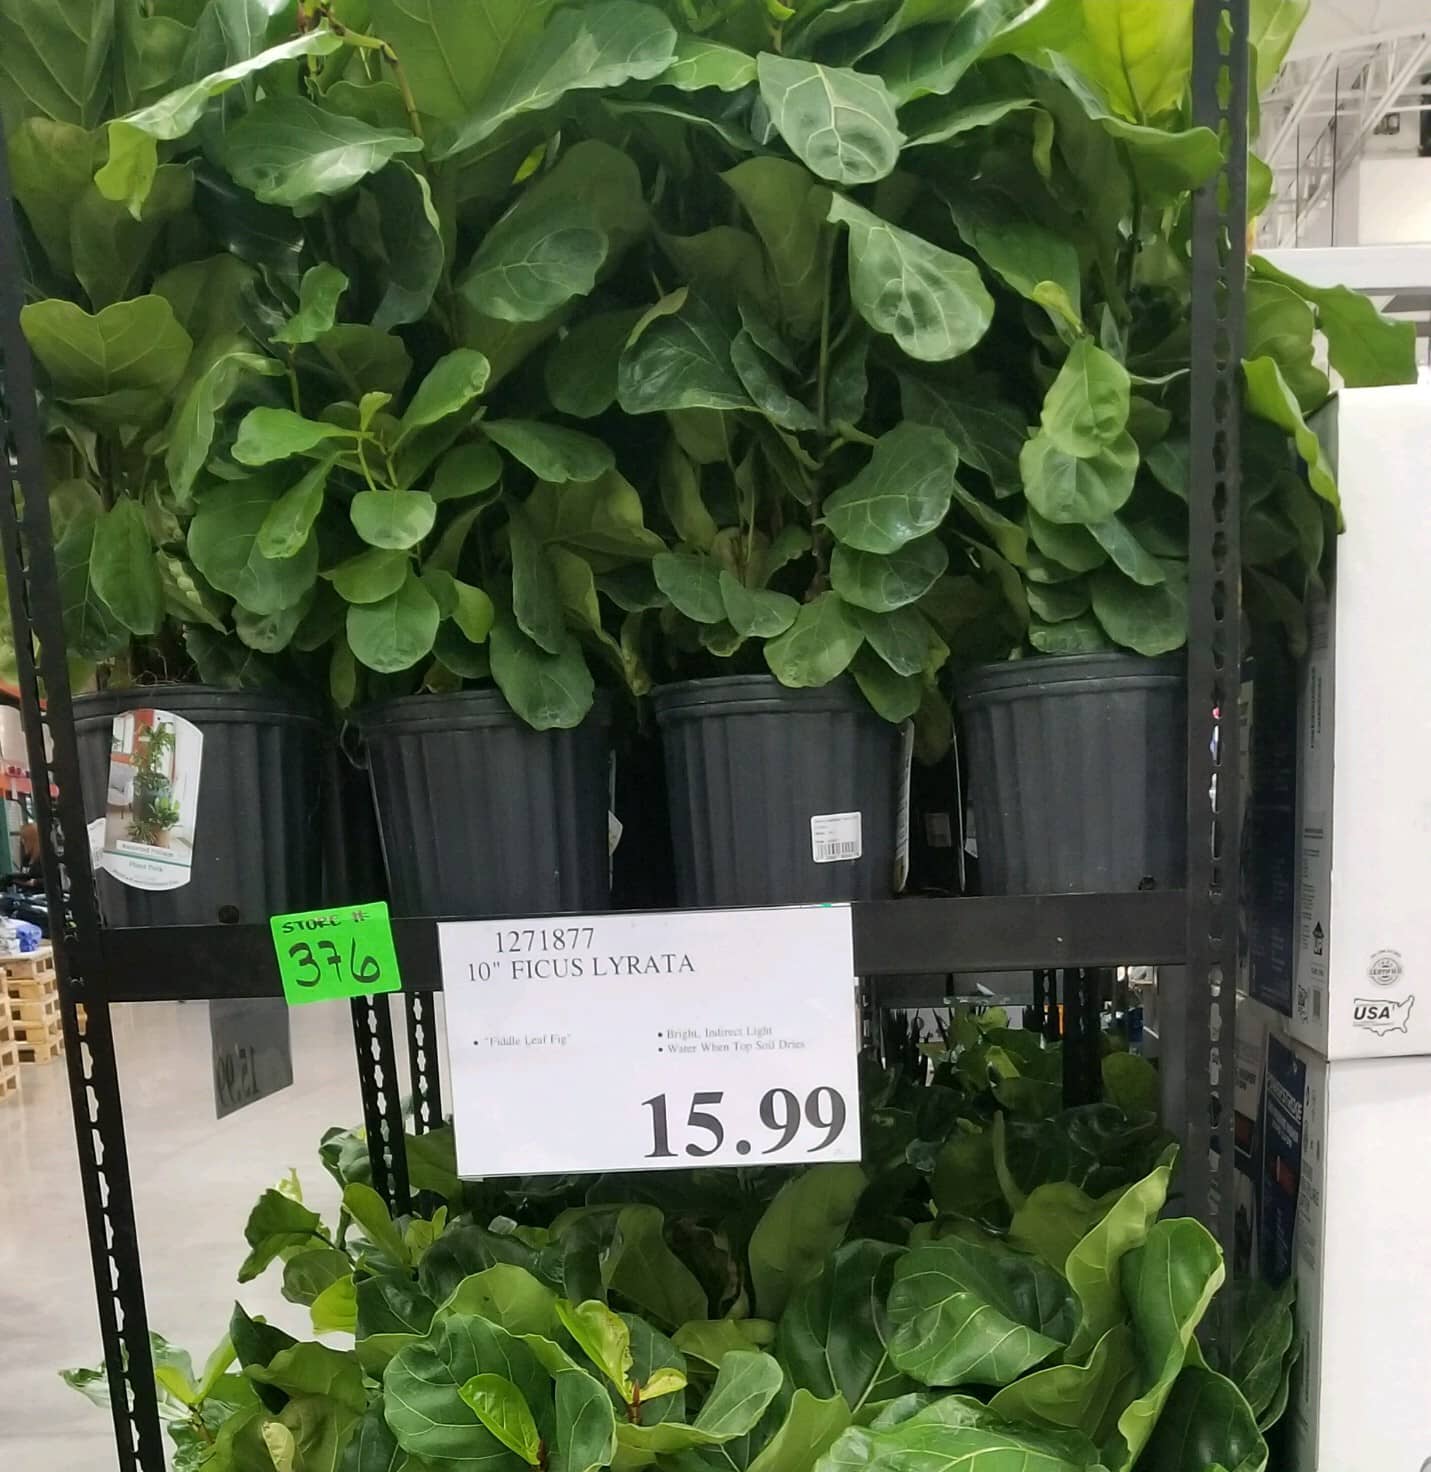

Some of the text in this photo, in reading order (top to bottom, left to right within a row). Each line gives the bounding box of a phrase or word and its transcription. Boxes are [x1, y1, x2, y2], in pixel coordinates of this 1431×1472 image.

[495, 927, 595, 953] 1271877
[288, 936, 380, 988] 376
[467, 953, 696, 983] 10" FICUS LYRATA
[1353, 1005, 1391, 1021] USA
[524, 1033, 547, 1047] Leaf
[704, 1026, 744, 1039] Indirect
[746, 1025, 773, 1038] Light
[667, 1042, 697, 1054] Water
[701, 1041, 730, 1053] When
[733, 1040, 753, 1053] Top
[641, 1086, 847, 1158] 15.99
